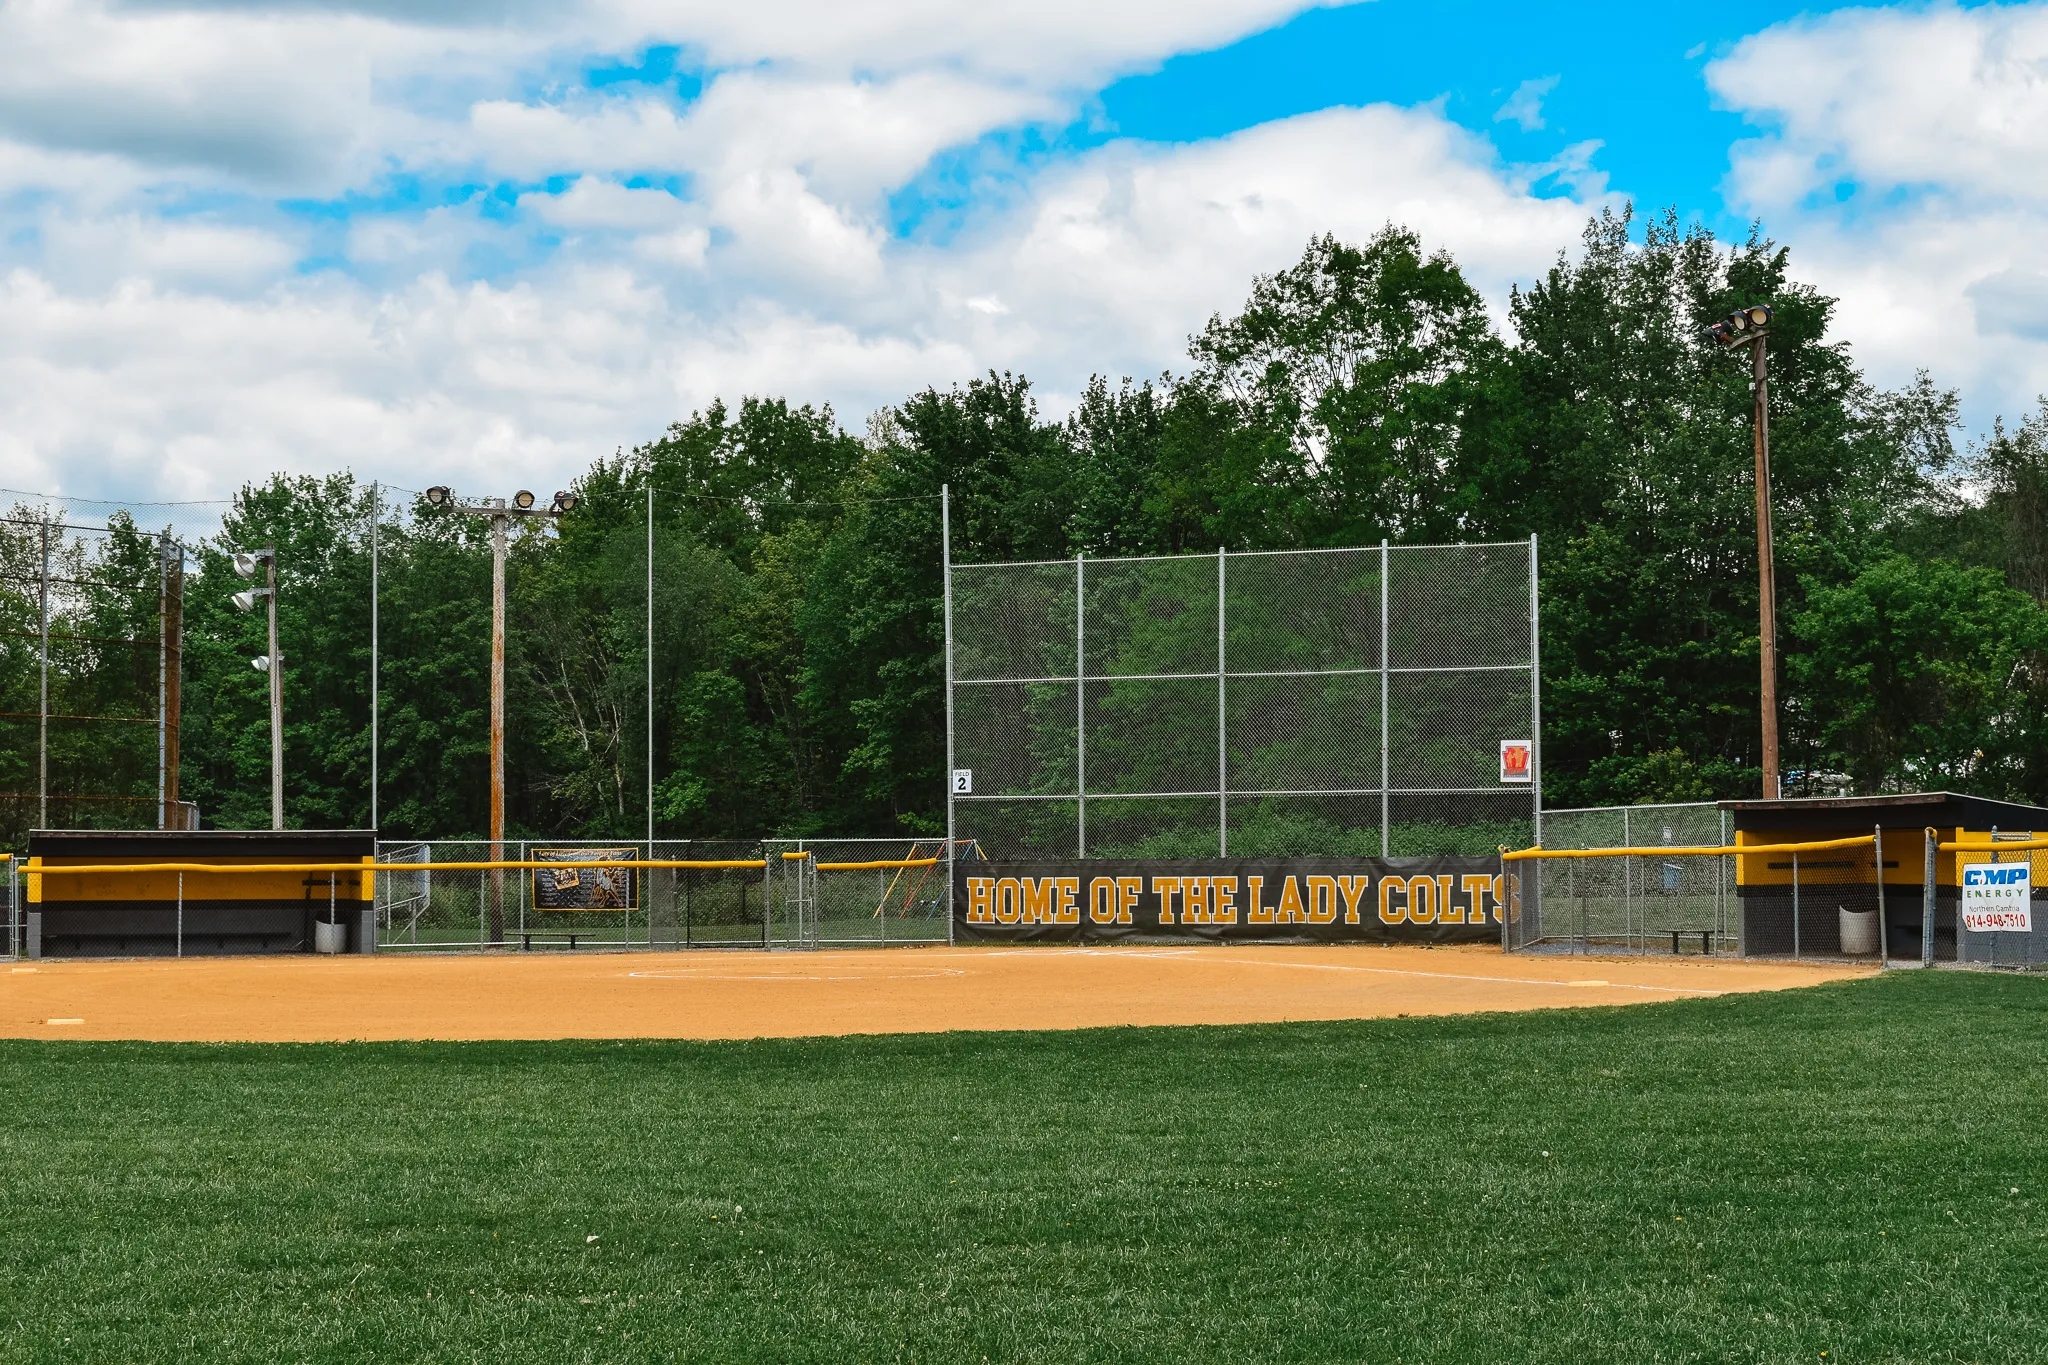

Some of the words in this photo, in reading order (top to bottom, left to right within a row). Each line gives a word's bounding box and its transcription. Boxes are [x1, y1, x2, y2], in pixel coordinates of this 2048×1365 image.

[958, 777, 966, 790] 2
[967, 877, 1079, 924] HOME
[1089, 877, 1142, 924] OF
[1152, 876, 1238, 924] THE
[1248, 875, 1368, 924] LADY
[1378, 874, 1520, 924] COLTS
[1967, 889, 2023, 898] ENERGY
[1966, 914, 2026, 927] 814-948-7510
